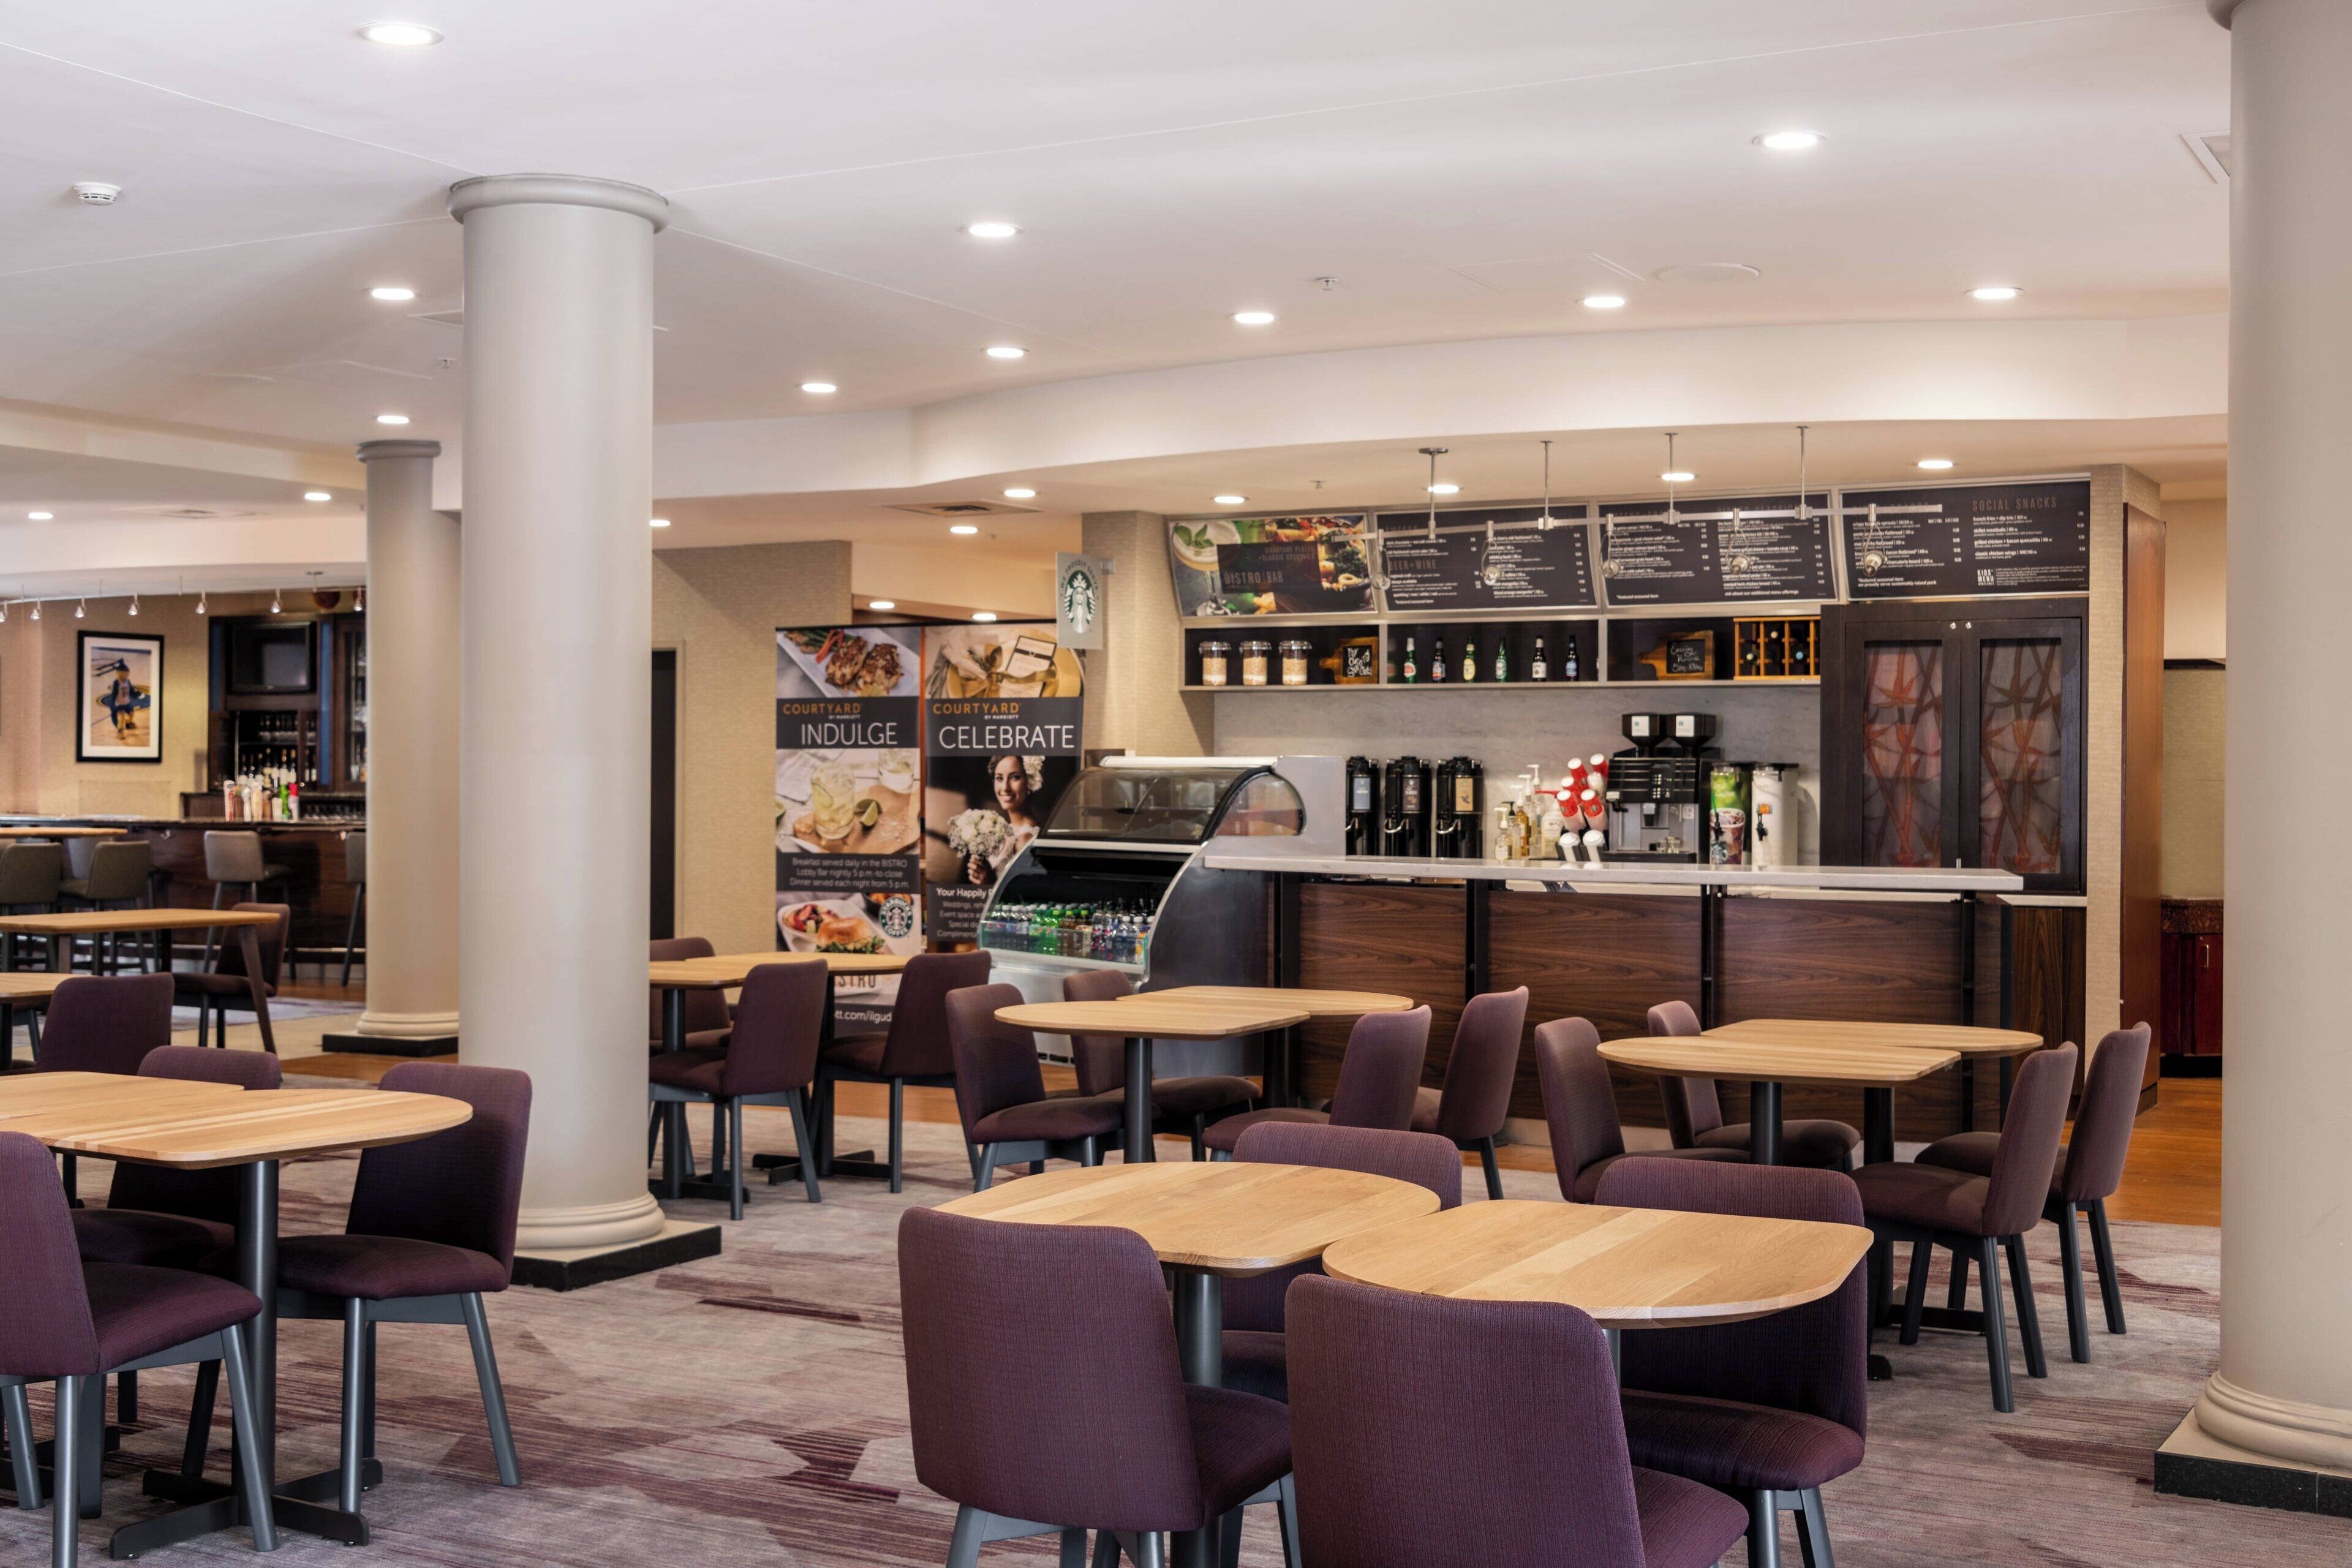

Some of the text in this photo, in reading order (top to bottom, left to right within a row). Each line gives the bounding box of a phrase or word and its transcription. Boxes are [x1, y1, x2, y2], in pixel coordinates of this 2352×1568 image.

[1973, 497, 2056, 511] SOCIAL SNACKS
[1415, 559, 1436, 569] WINE
[1224, 571, 1283, 585] BISTRO BAR
[783, 703, 861, 715] COURTYARD
[933, 703, 1019, 714] COURTYARD
[801, 722, 898, 745] INDULGE
[938, 725, 1075, 749] CELEBRATE
[844, 859, 860, 868] daily
[829, 869, 852, 878] nightly
[853, 880, 870, 888] night
[936, 888, 955, 897] Your
[956, 888, 987, 899] Happily
[881, 897, 913, 915] STARBUCKS
[884, 925, 910, 937] COFFEE
[839, 975, 876, 987] STRO
[835, 1009, 892, 1024] tt.com/ilgud
